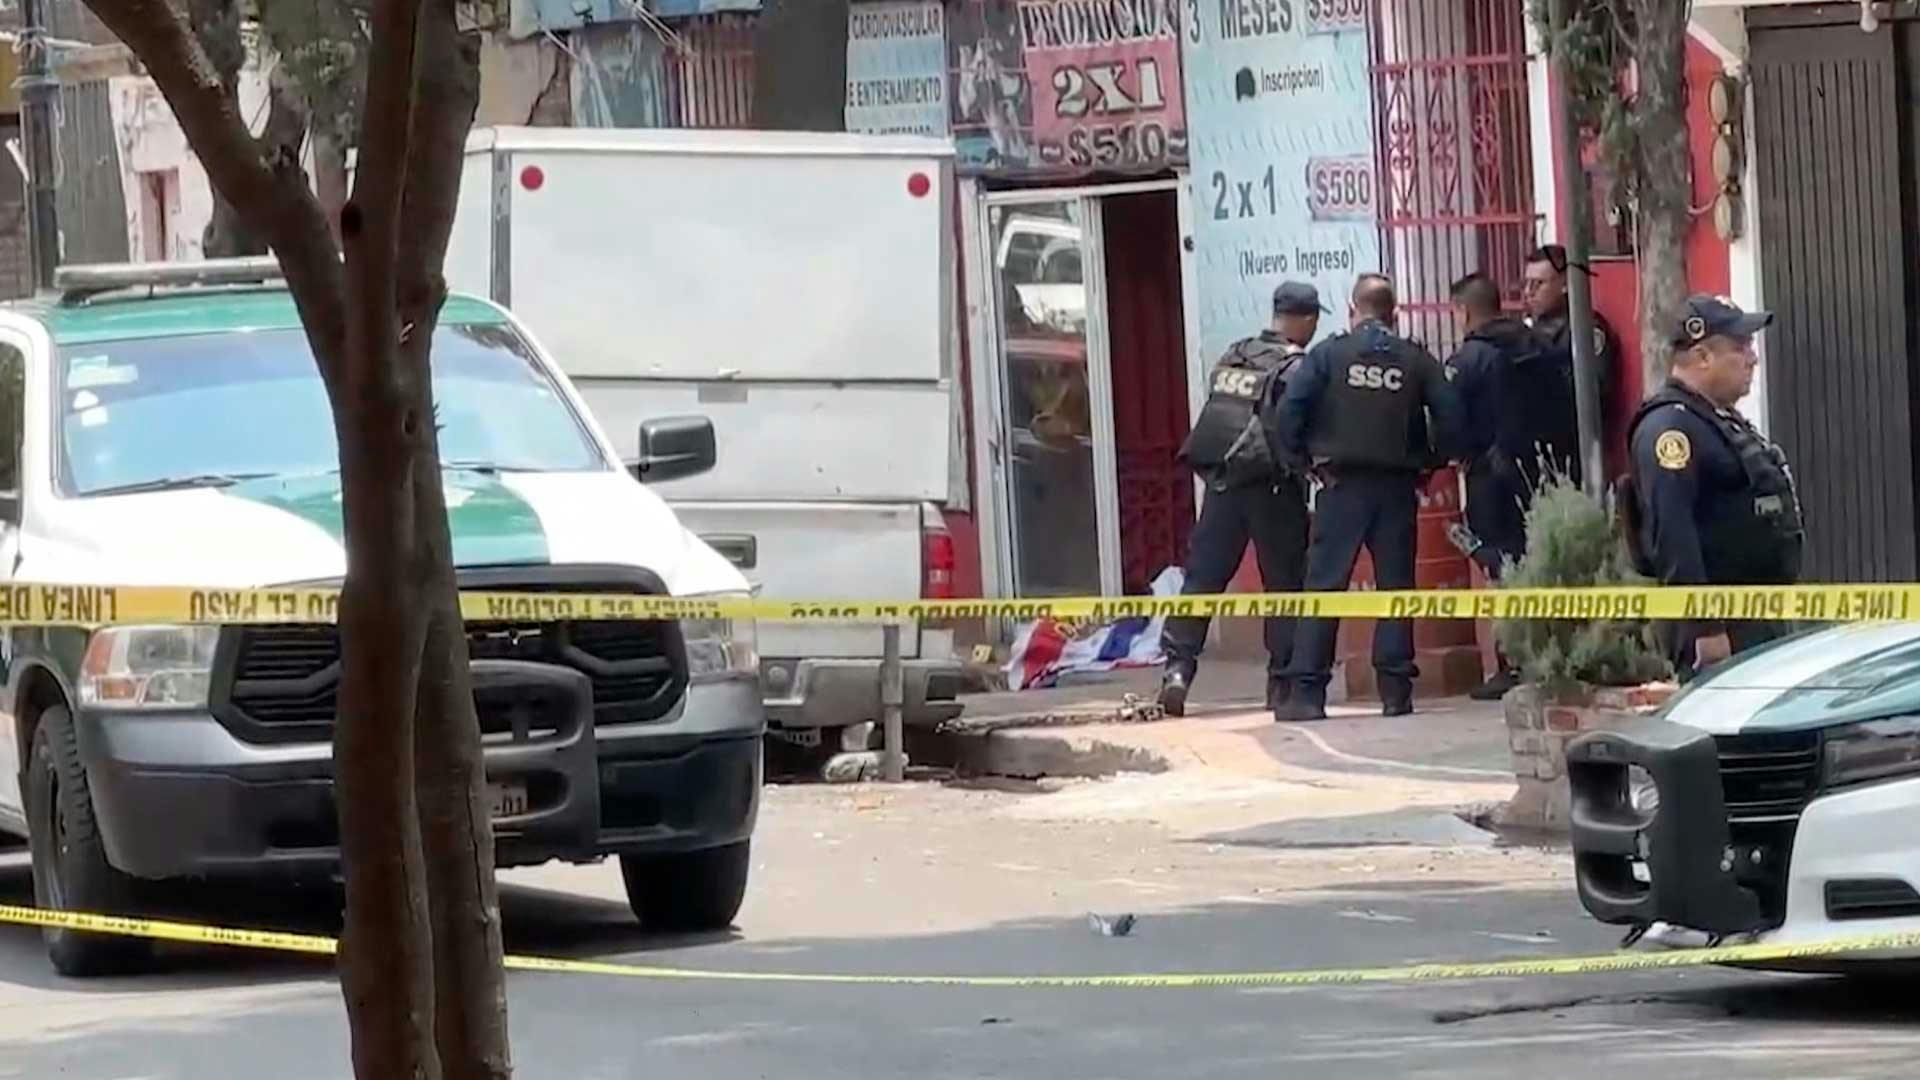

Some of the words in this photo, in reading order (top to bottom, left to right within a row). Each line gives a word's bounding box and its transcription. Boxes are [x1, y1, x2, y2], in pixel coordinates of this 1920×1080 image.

[852, 8, 942, 39] CARDIOVASCULAR
[1188, 0, 1201, 43] 3
[1219, 0, 1293, 40] MESES
[857, 77, 942, 107] ENTRENAMIENTO
[1211, 170, 1230, 221] 2
[1262, 164, 1277, 216] 1
[1314, 163, 1371, 207] $580
[1295, 246, 1356, 277] Ingreso)
[1213, 370, 1257, 397] SSC
[1347, 363, 1404, 392] SSC
[42, 585, 118, 622] LINEA
